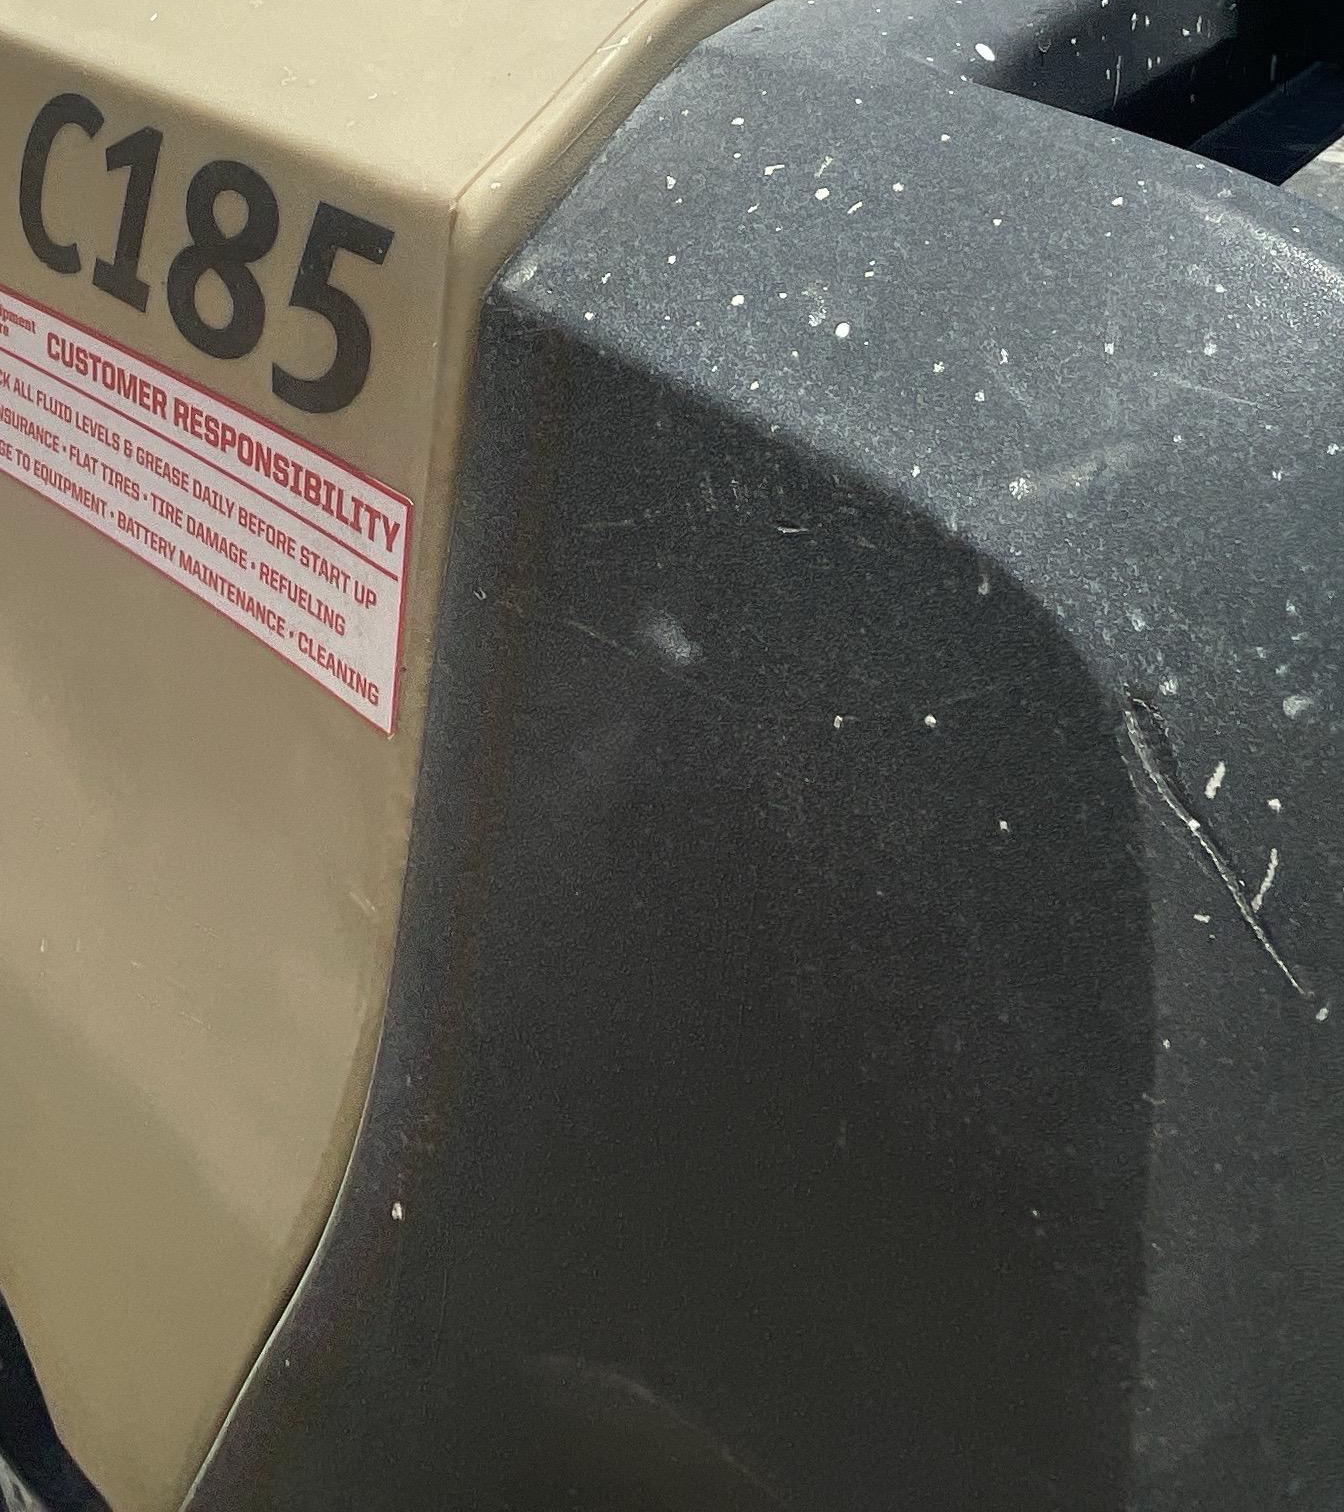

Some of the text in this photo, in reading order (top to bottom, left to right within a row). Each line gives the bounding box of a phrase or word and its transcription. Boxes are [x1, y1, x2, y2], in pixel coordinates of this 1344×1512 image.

[18, 92, 396, 415] C185
[13, 377, 35, 403] ALL
[36, 389, 73, 424] FLUID
[75, 410, 121, 452] LEVELS
[123, 438, 133, 459] &
[136, 445, 189, 493] GREASE
[192, 478, 235, 519] DAILY
[238, 506, 296, 560] BEFORE
[300, 544, 351, 594] START
[354, 579, 377, 610] UP
[46, 331, 401, 553] CUSTOMER RESPONSIBILITY
[69, 444, 98, 476] FLAT
[100, 461, 140, 502] TIRES
[150, 491, 183, 529] TIRE
[186, 514, 248, 571] DAMAGE
[258, 561, 346, 637] REFUELING
[15, 448, 31, 473] TO
[33, 458, 108, 519] EQUIPMENT
[117, 510, 177, 563] BATTERY
[178, 549, 287, 639] MAINTENANCE
[297, 631, 380, 707] CLEANING
